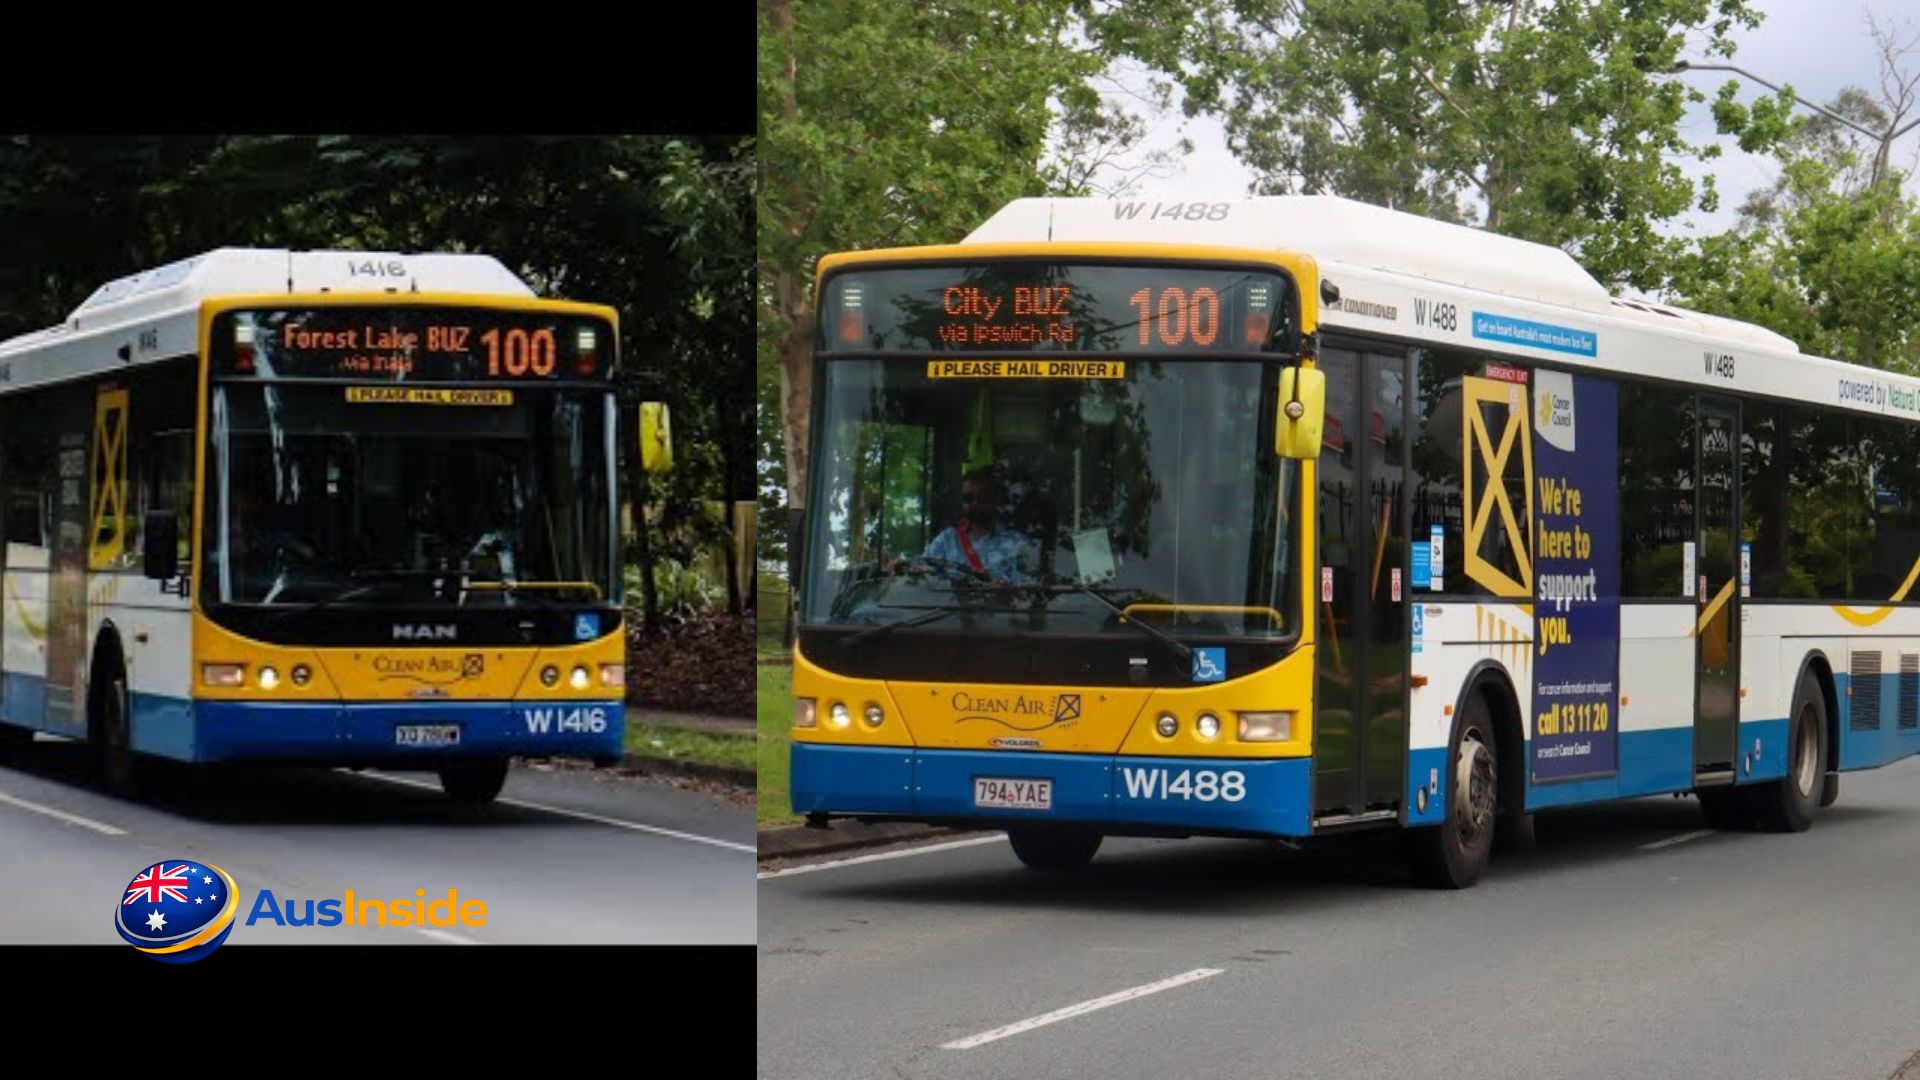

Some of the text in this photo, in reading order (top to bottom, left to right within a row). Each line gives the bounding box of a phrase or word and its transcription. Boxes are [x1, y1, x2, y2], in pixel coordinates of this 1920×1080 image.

[943, 287, 1071, 321] City BUZ
[1130, 287, 1221, 346] 100
[1344, 298, 1397, 321] CONDITIONED
[284, 323, 470, 352] Forest Lake BUZ
[938, 323, 1075, 344] via Ipswich Rd
[1478, 318, 1489, 333] Get
[1497, 321, 1512, 337] board
[1539, 332, 1551, 344] most
[480, 327, 557, 377] 100
[944, 362, 1108, 378] PLEASE HAIL DRIVER
[1553, 393, 1570, 410] Cancer
[1838, 379, 1875, 404] powered
[1876, 380, 1886, 412] by
[1888, 383, 1916, 412] Natural
[1553, 410, 1571, 427] Council
[1538, 518, 1591, 560] here to
[1538, 567, 1597, 612] support
[392, 623, 458, 639] MAN
[1538, 616, 1572, 657] you.
[1537, 702, 1609, 735] call 13 11 20
[1004, 739, 1041, 748] VOLGREN
[1575, 741, 1591, 755] Council
[1123, 767, 1246, 802] W1488
